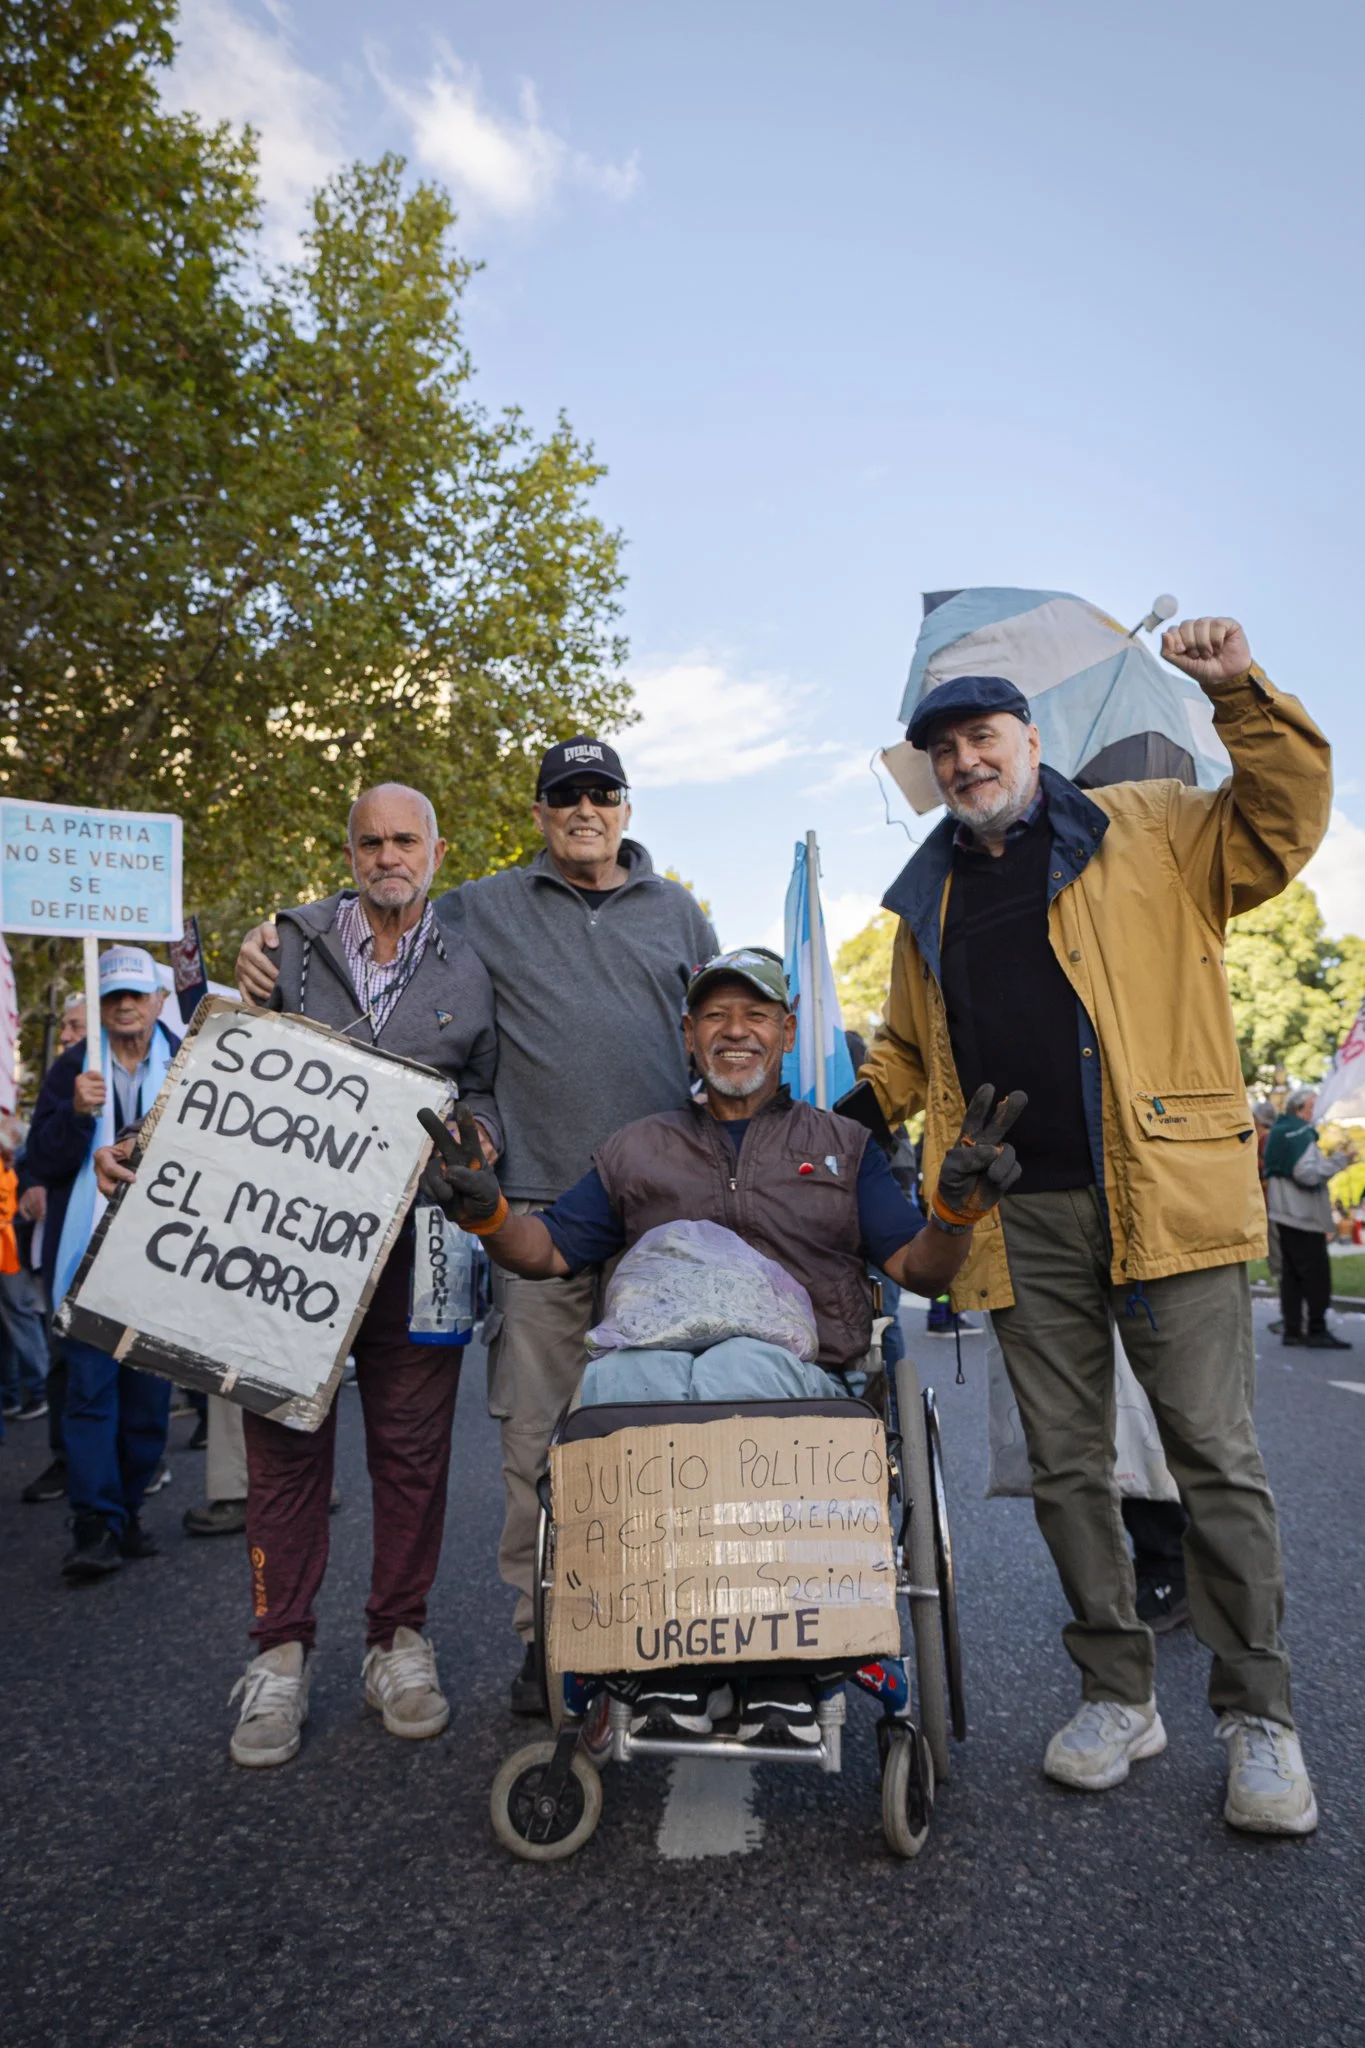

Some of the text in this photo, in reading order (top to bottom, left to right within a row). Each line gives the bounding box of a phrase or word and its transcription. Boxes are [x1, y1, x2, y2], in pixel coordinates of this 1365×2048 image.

[25, 815, 151, 843] LA PATRIA
[5, 844, 166, 872] NO SE VENDE
[69, 876, 102, 894] SE
[31, 900, 149, 923] DEFIENDE
[211, 1028, 369, 1114] SODA
[146, 1161, 381, 1262] EL MEJOR
[428, 1207, 450, 1325] ADORNI
[586, 1520, 605, 1553] A
[618, 1505, 715, 1549] ESTE
[636, 1608, 820, 1660] URGENTE
